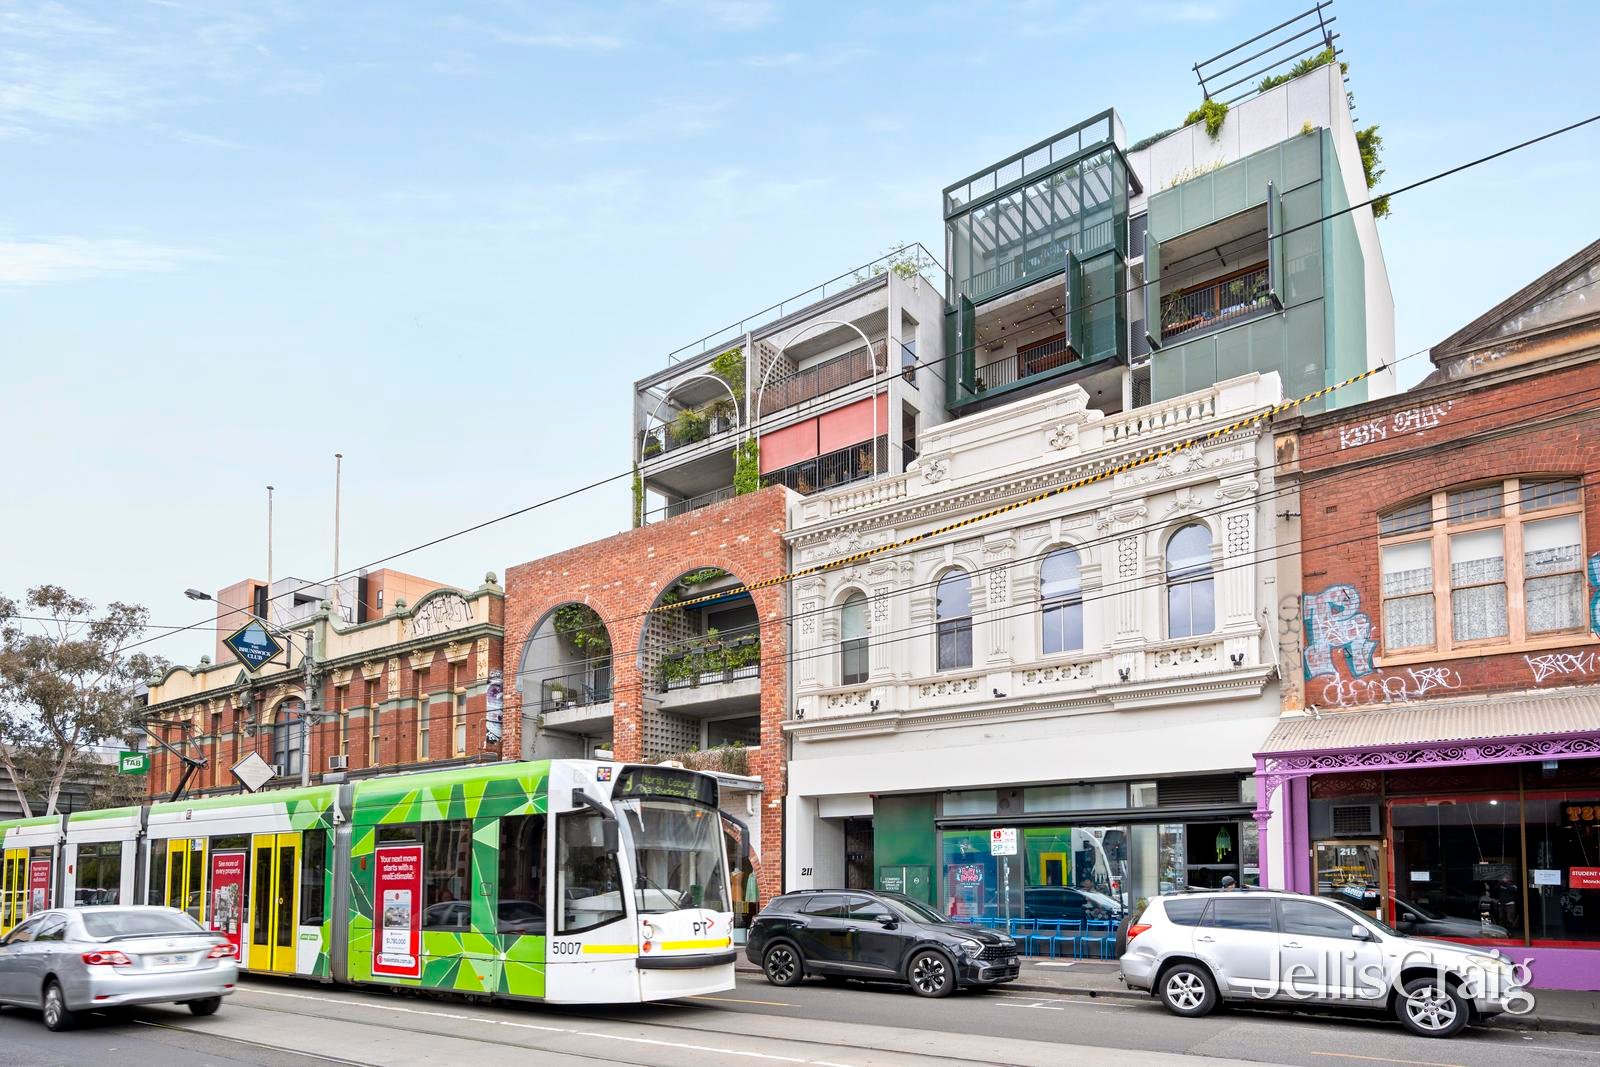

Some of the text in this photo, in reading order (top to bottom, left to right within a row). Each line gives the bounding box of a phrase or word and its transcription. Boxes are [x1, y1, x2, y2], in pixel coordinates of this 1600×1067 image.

[239, 647, 271, 656] BRUNSWICK
[641, 775, 665, 786] North
[655, 786, 685, 797] Sydney
[687, 789, 698, 799] Rd
[993, 844, 1003, 852] 2P
[801, 868, 813, 876] 211
[552, 941, 582, 955] 5007
